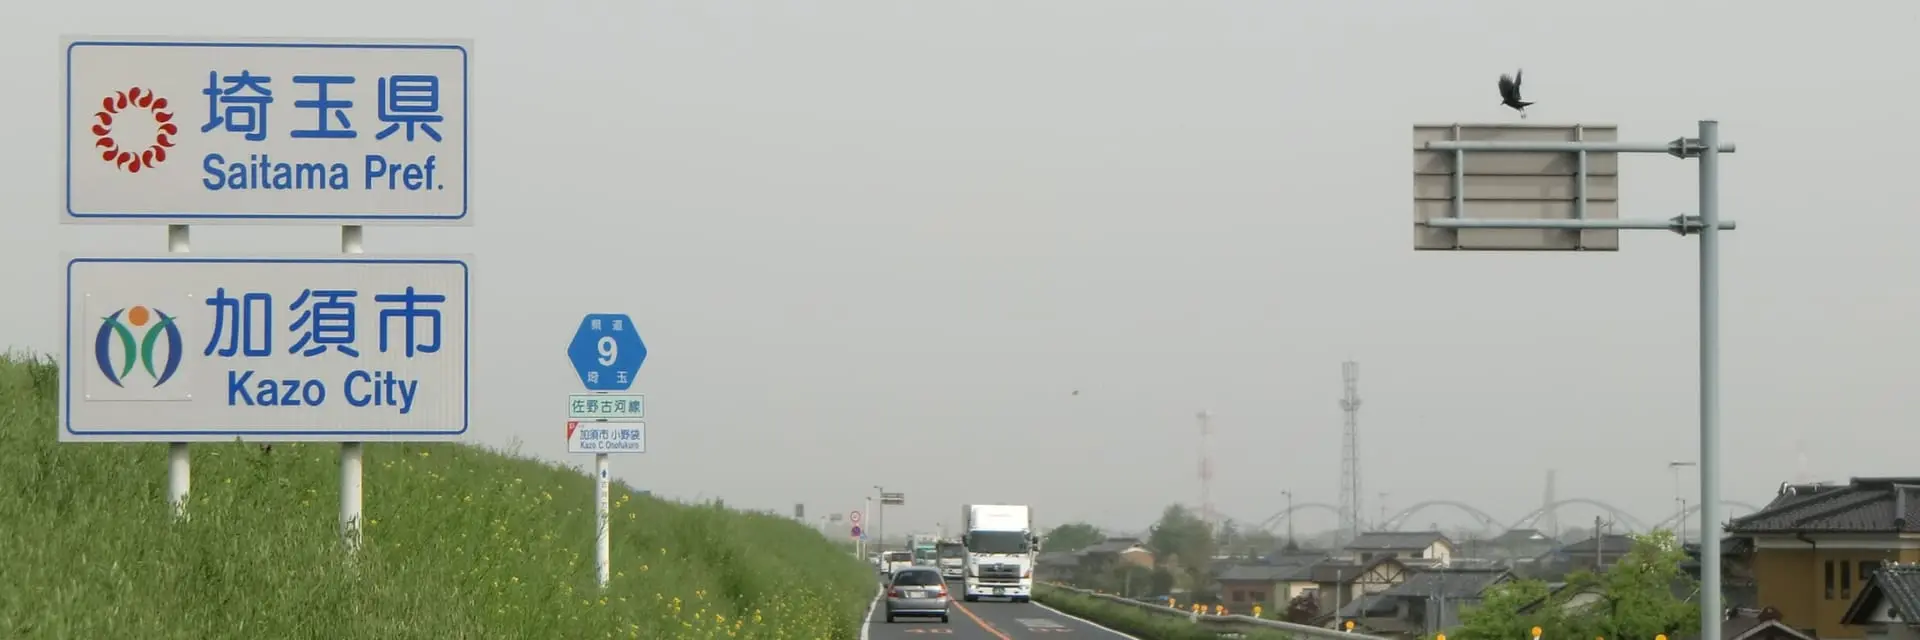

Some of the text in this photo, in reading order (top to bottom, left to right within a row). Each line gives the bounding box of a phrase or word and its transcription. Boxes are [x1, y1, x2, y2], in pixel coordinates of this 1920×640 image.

[201, 70, 443, 141] 埼玉県
[202, 153, 443, 190] Saitama Pref.
[204, 286, 446, 358] 加須市
[597, 336, 618, 367] 9
[227, 370, 418, 414] Kazo City
[572, 399, 641, 413] 佐野古河線
